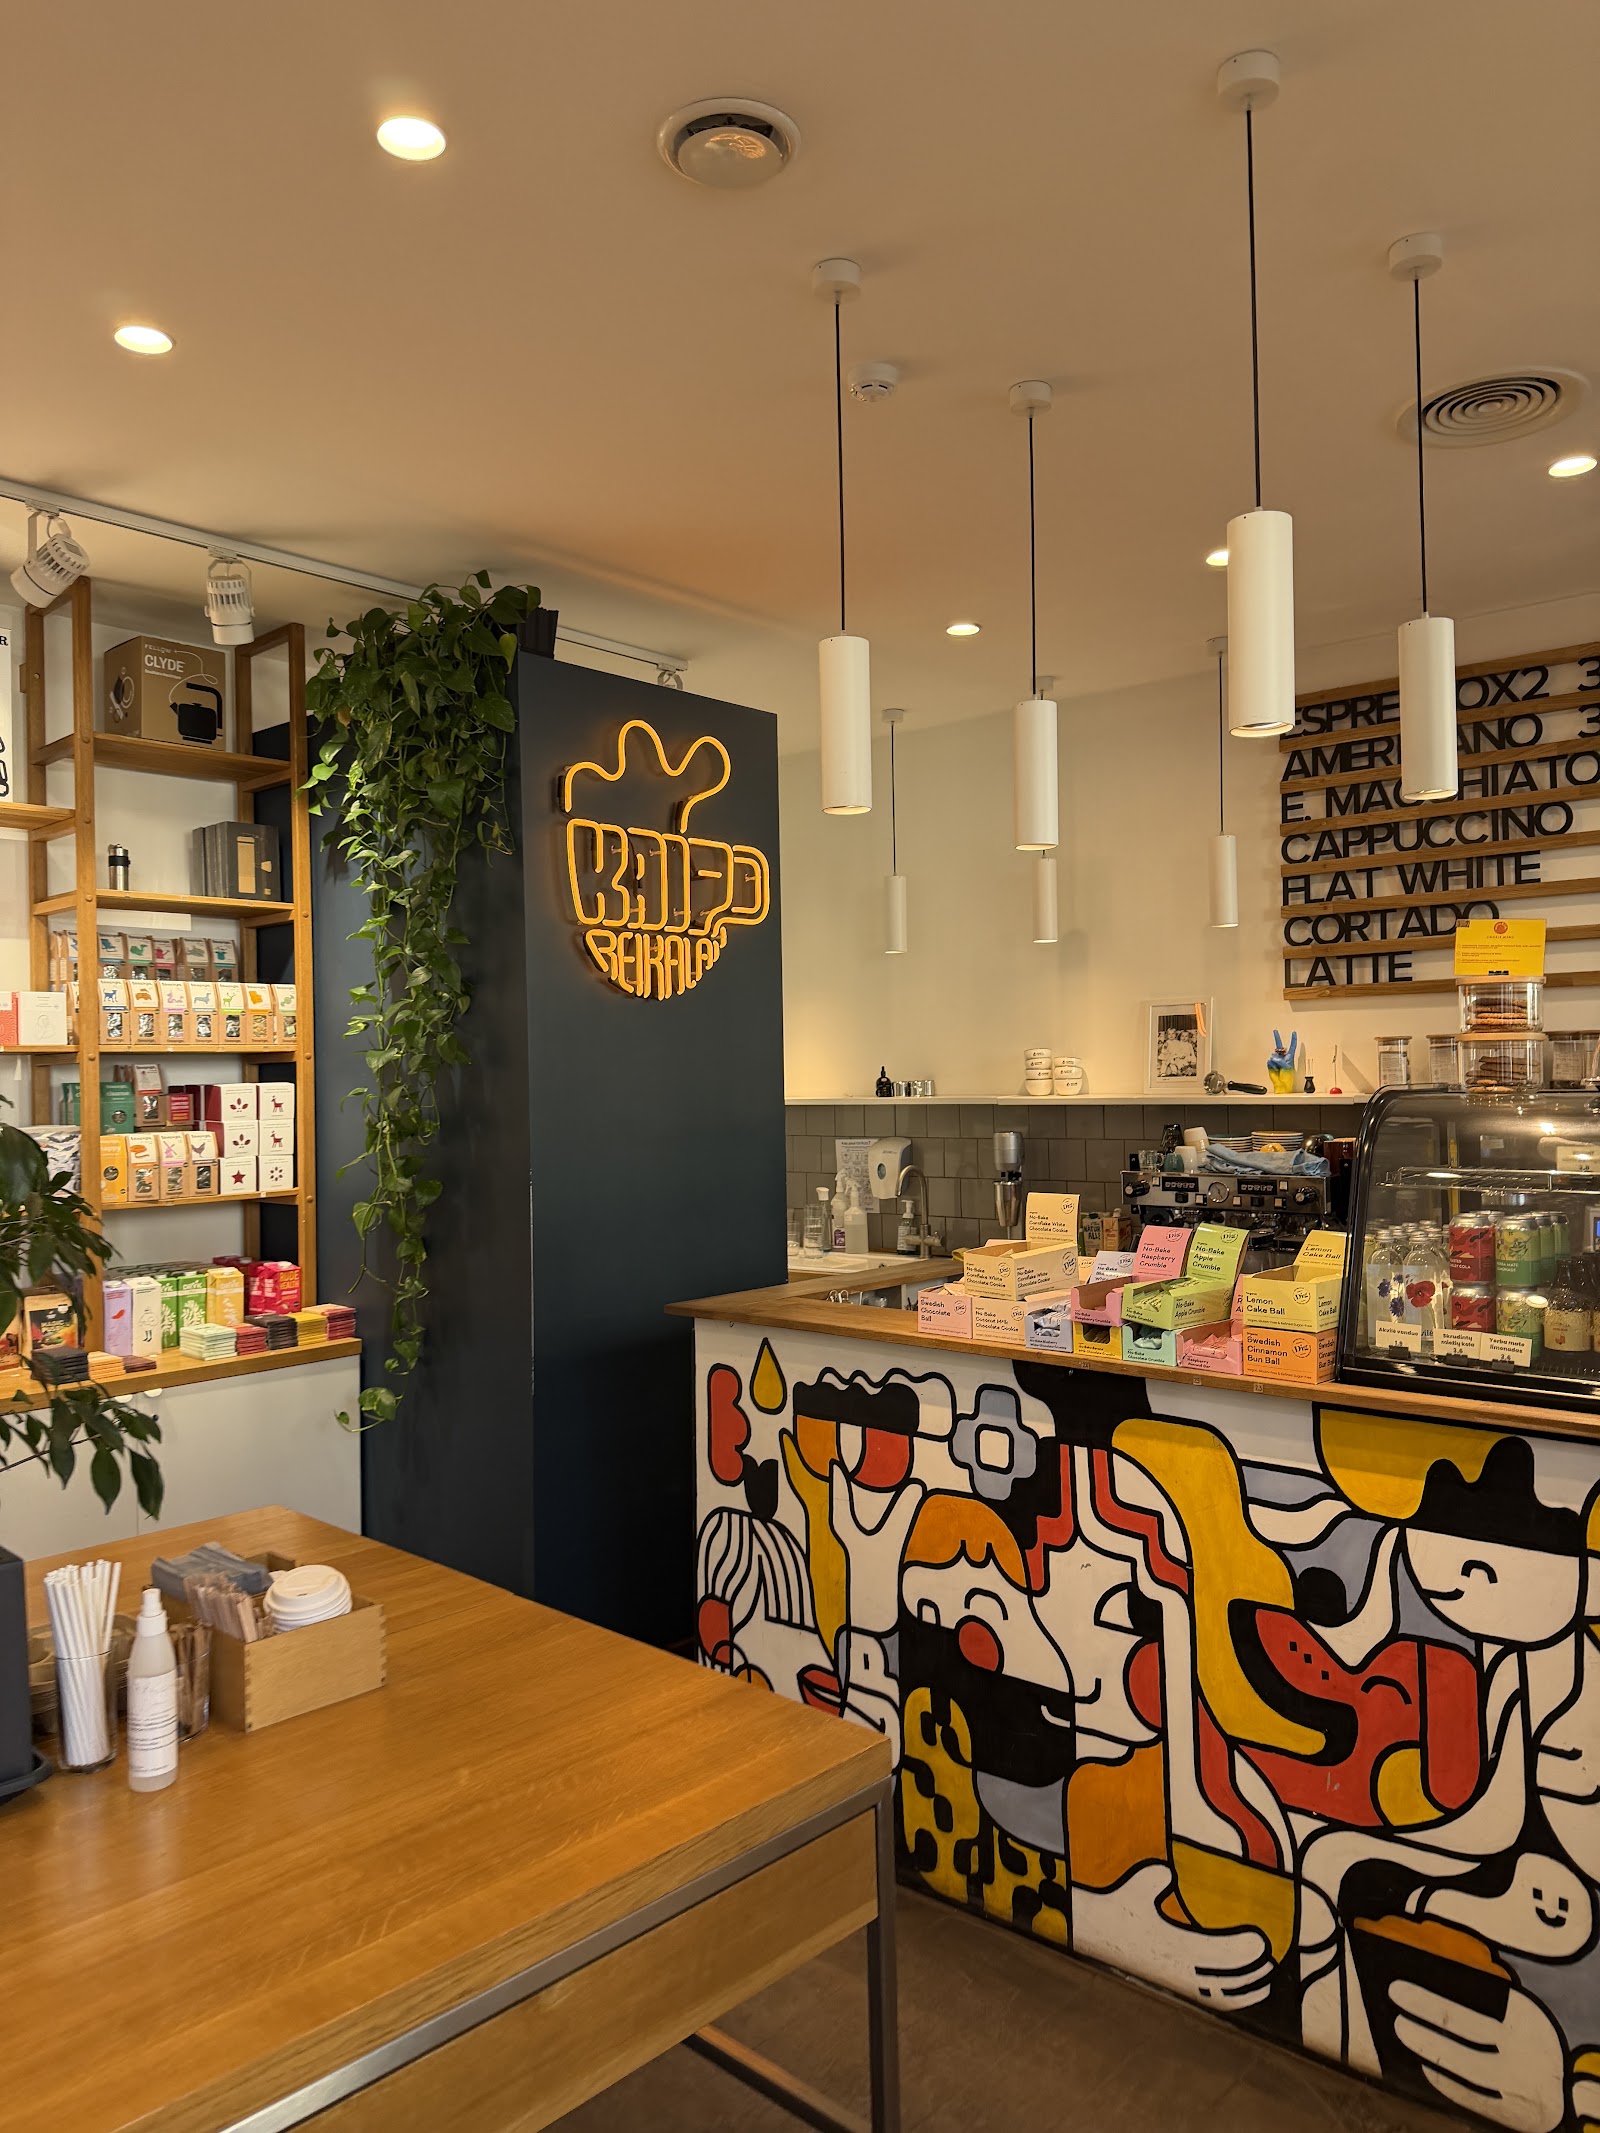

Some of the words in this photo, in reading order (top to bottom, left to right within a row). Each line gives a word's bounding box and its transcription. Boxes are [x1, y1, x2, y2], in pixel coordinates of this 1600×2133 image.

[144, 655, 185, 673] CLYDE
[1282, 791, 1311, 824] E.
[1281, 800, 1573, 864] CAPPUCCINO
[1283, 866, 1383, 906] FLAT
[1397, 850, 1541, 894] WHITE
[1285, 950, 1412, 988] LATTE
[1142, 1246, 1171, 1254] No-Bake
[1195, 1245, 1225, 1255] No-Bake
[1141, 1253, 1176, 1263] Raspberry
[1193, 1253, 1213, 1263] Apple
[1139, 1261, 1167, 1269] Crumble
[1192, 1261, 1221, 1272] Crumble
[920, 1299, 945, 1309] Swedish
[1175, 1300, 1195, 1309] No-Bake
[1246, 1296, 1274, 1305] Lemon
[1318, 1300, 1332, 1308] Lemon
[920, 1307, 951, 1317] Chocolate
[1174, 1308, 1187, 1319] Apple
[1187, 1306, 1206, 1316] Crumble
[1246, 1304, 1268, 1314] Cake
[1269, 1307, 1286, 1315] Ball
[1318, 1309, 1329, 1317] Cake
[975, 1322, 1000, 1330] Chocolate
[1247, 1336, 1281, 1347] Swedish
[1489, 1337, 1507, 1345] Yerba
[1247, 1345, 1288, 1357] Cinnamon
[1247, 1354, 1263, 1363] Bun
[1265, 1356, 1280, 1365] Ball
